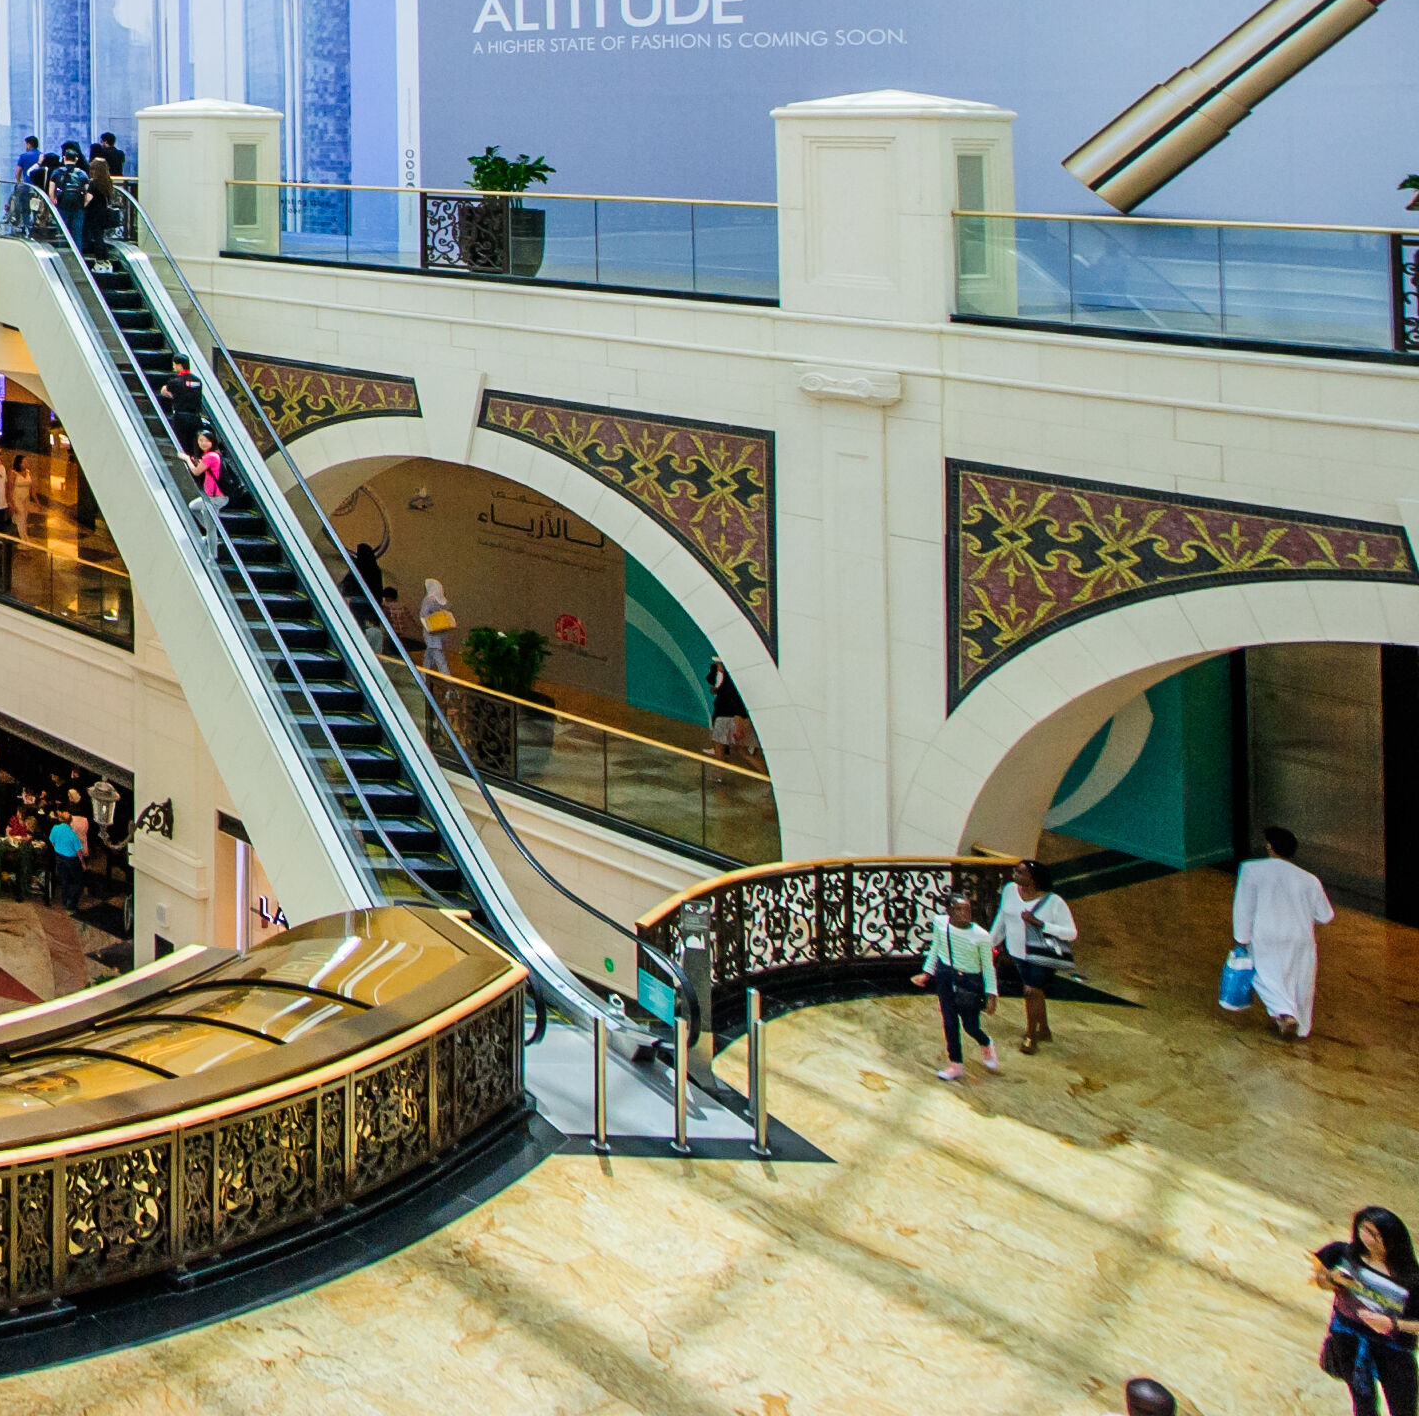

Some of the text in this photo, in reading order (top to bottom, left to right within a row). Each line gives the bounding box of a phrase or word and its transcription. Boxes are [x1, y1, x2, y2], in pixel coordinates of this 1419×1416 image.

[472, 28, 908, 55] A HIGHER STATE OF FASHION IS COMING SOON.
